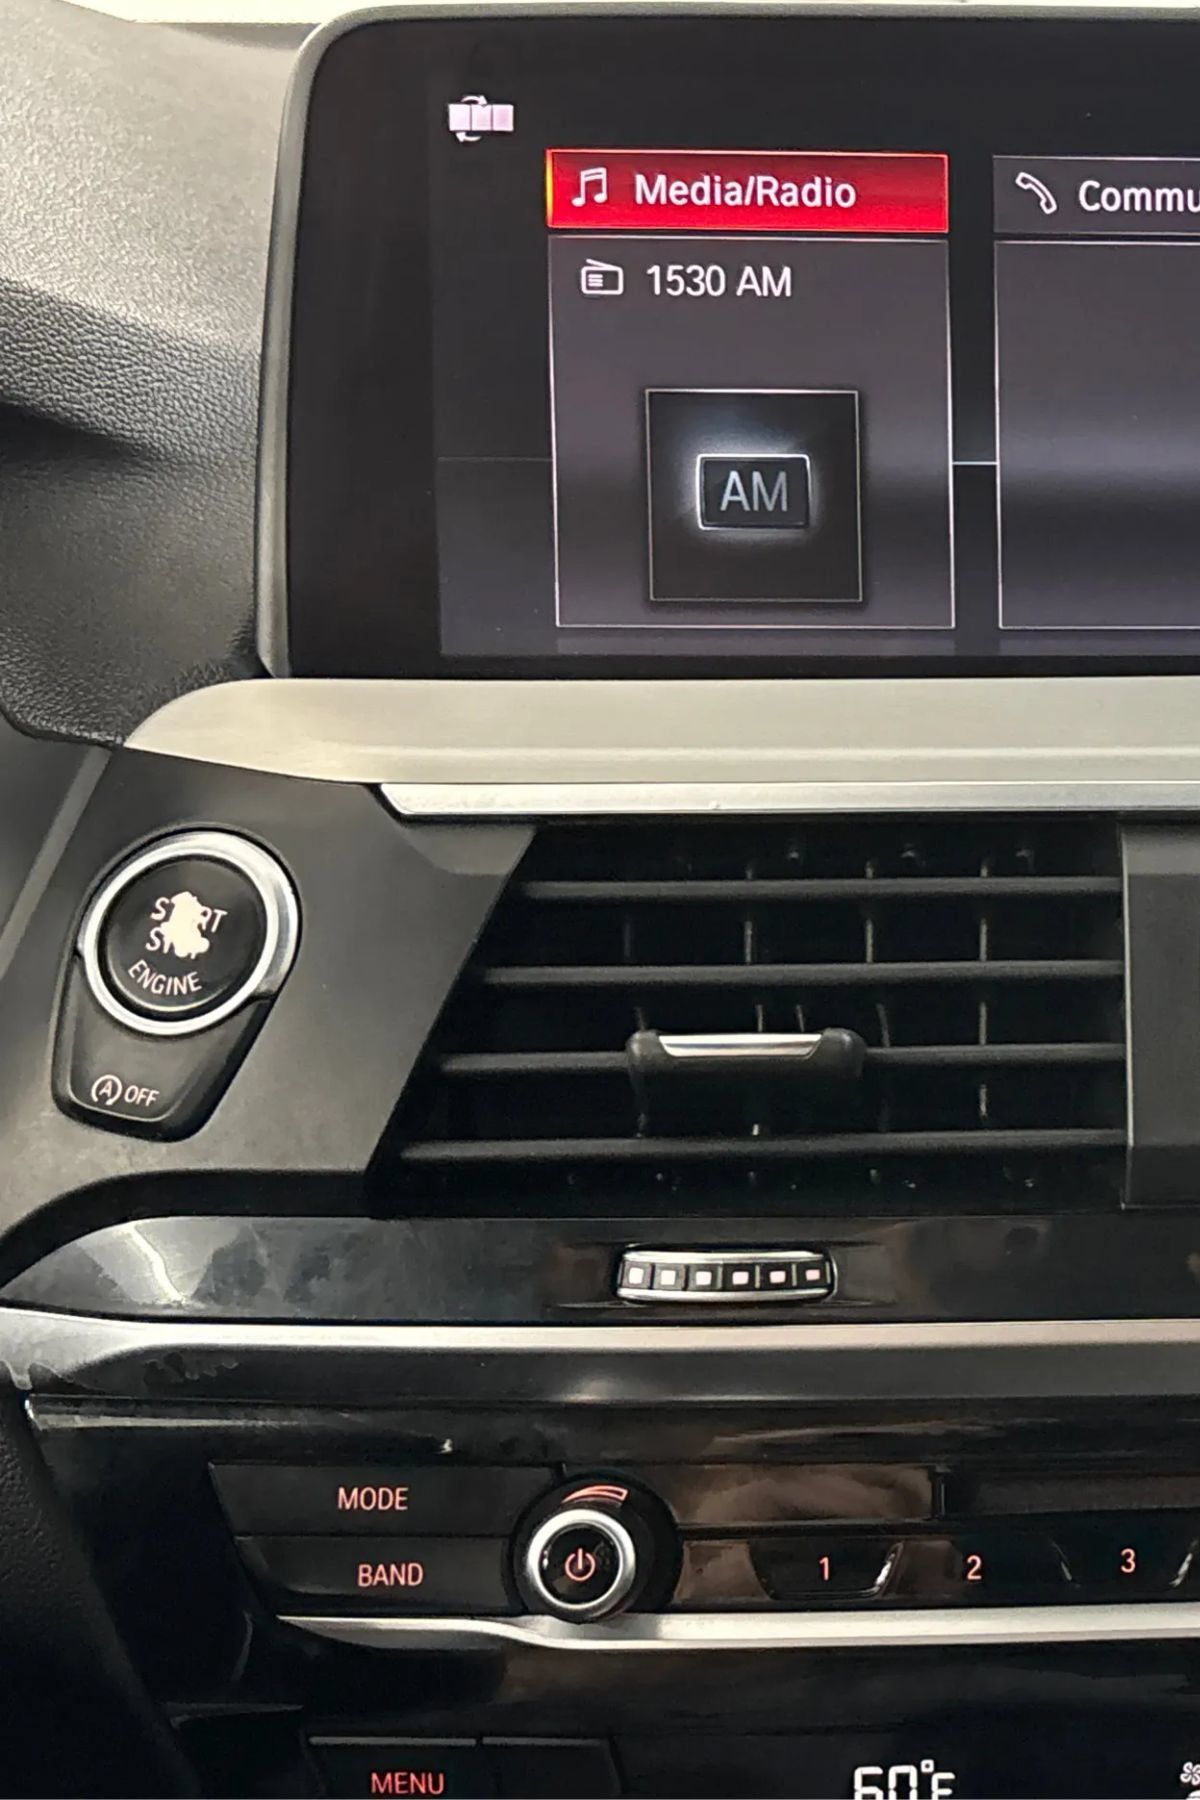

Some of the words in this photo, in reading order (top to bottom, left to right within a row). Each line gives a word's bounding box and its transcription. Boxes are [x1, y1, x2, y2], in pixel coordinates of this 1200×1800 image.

[634, 173, 857, 209] Media/Radio
[646, 265, 727, 297] 1530
[736, 266, 793, 298] AM
[719, 470, 788, 512] AM
[128, 959, 202, 995] ENGINE
[124, 1085, 160, 1107] OFF
[336, 1486, 409, 1513] MODE
[818, 1557, 831, 1581] 1
[965, 1555, 983, 1581] 2
[1119, 1548, 1137, 1574] 3
[356, 1563, 424, 1588] BAND
[370, 1769, 445, 1797] MENU
